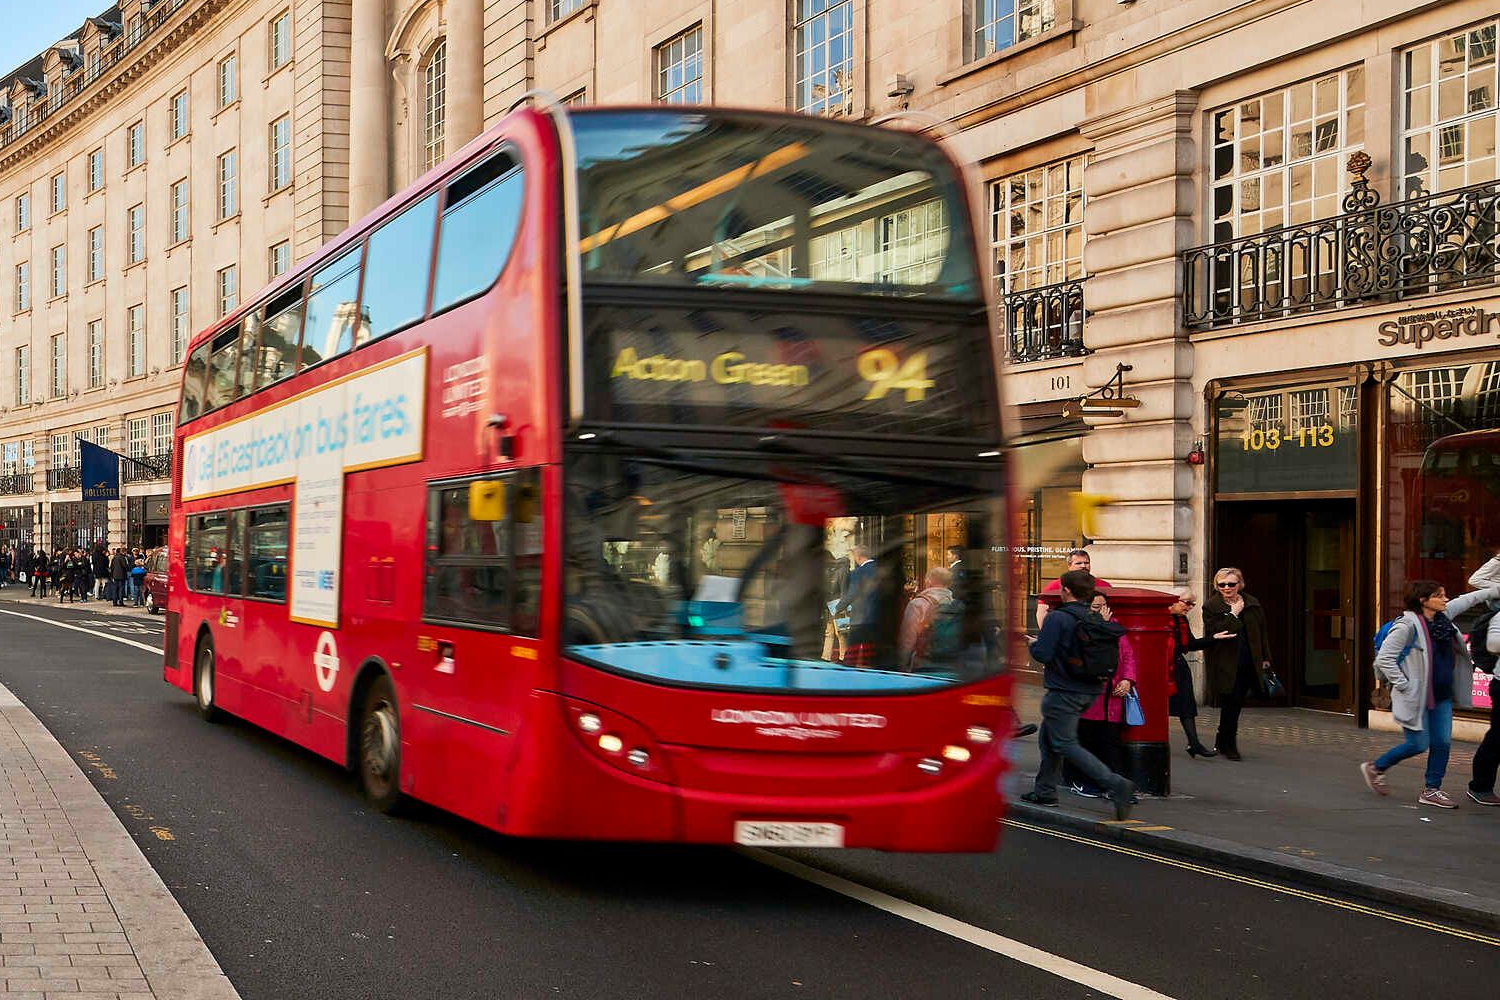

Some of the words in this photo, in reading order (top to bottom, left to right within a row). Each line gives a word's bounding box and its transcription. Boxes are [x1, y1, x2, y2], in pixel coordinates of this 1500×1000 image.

[611, 347, 707, 383] Acton
[711, 352, 810, 386] Green
[856, 348, 936, 402] 94
[1051, 375, 1070, 390] 101
[316, 405, 349, 454] bus
[84, 488, 116, 496] HOLLISTER
